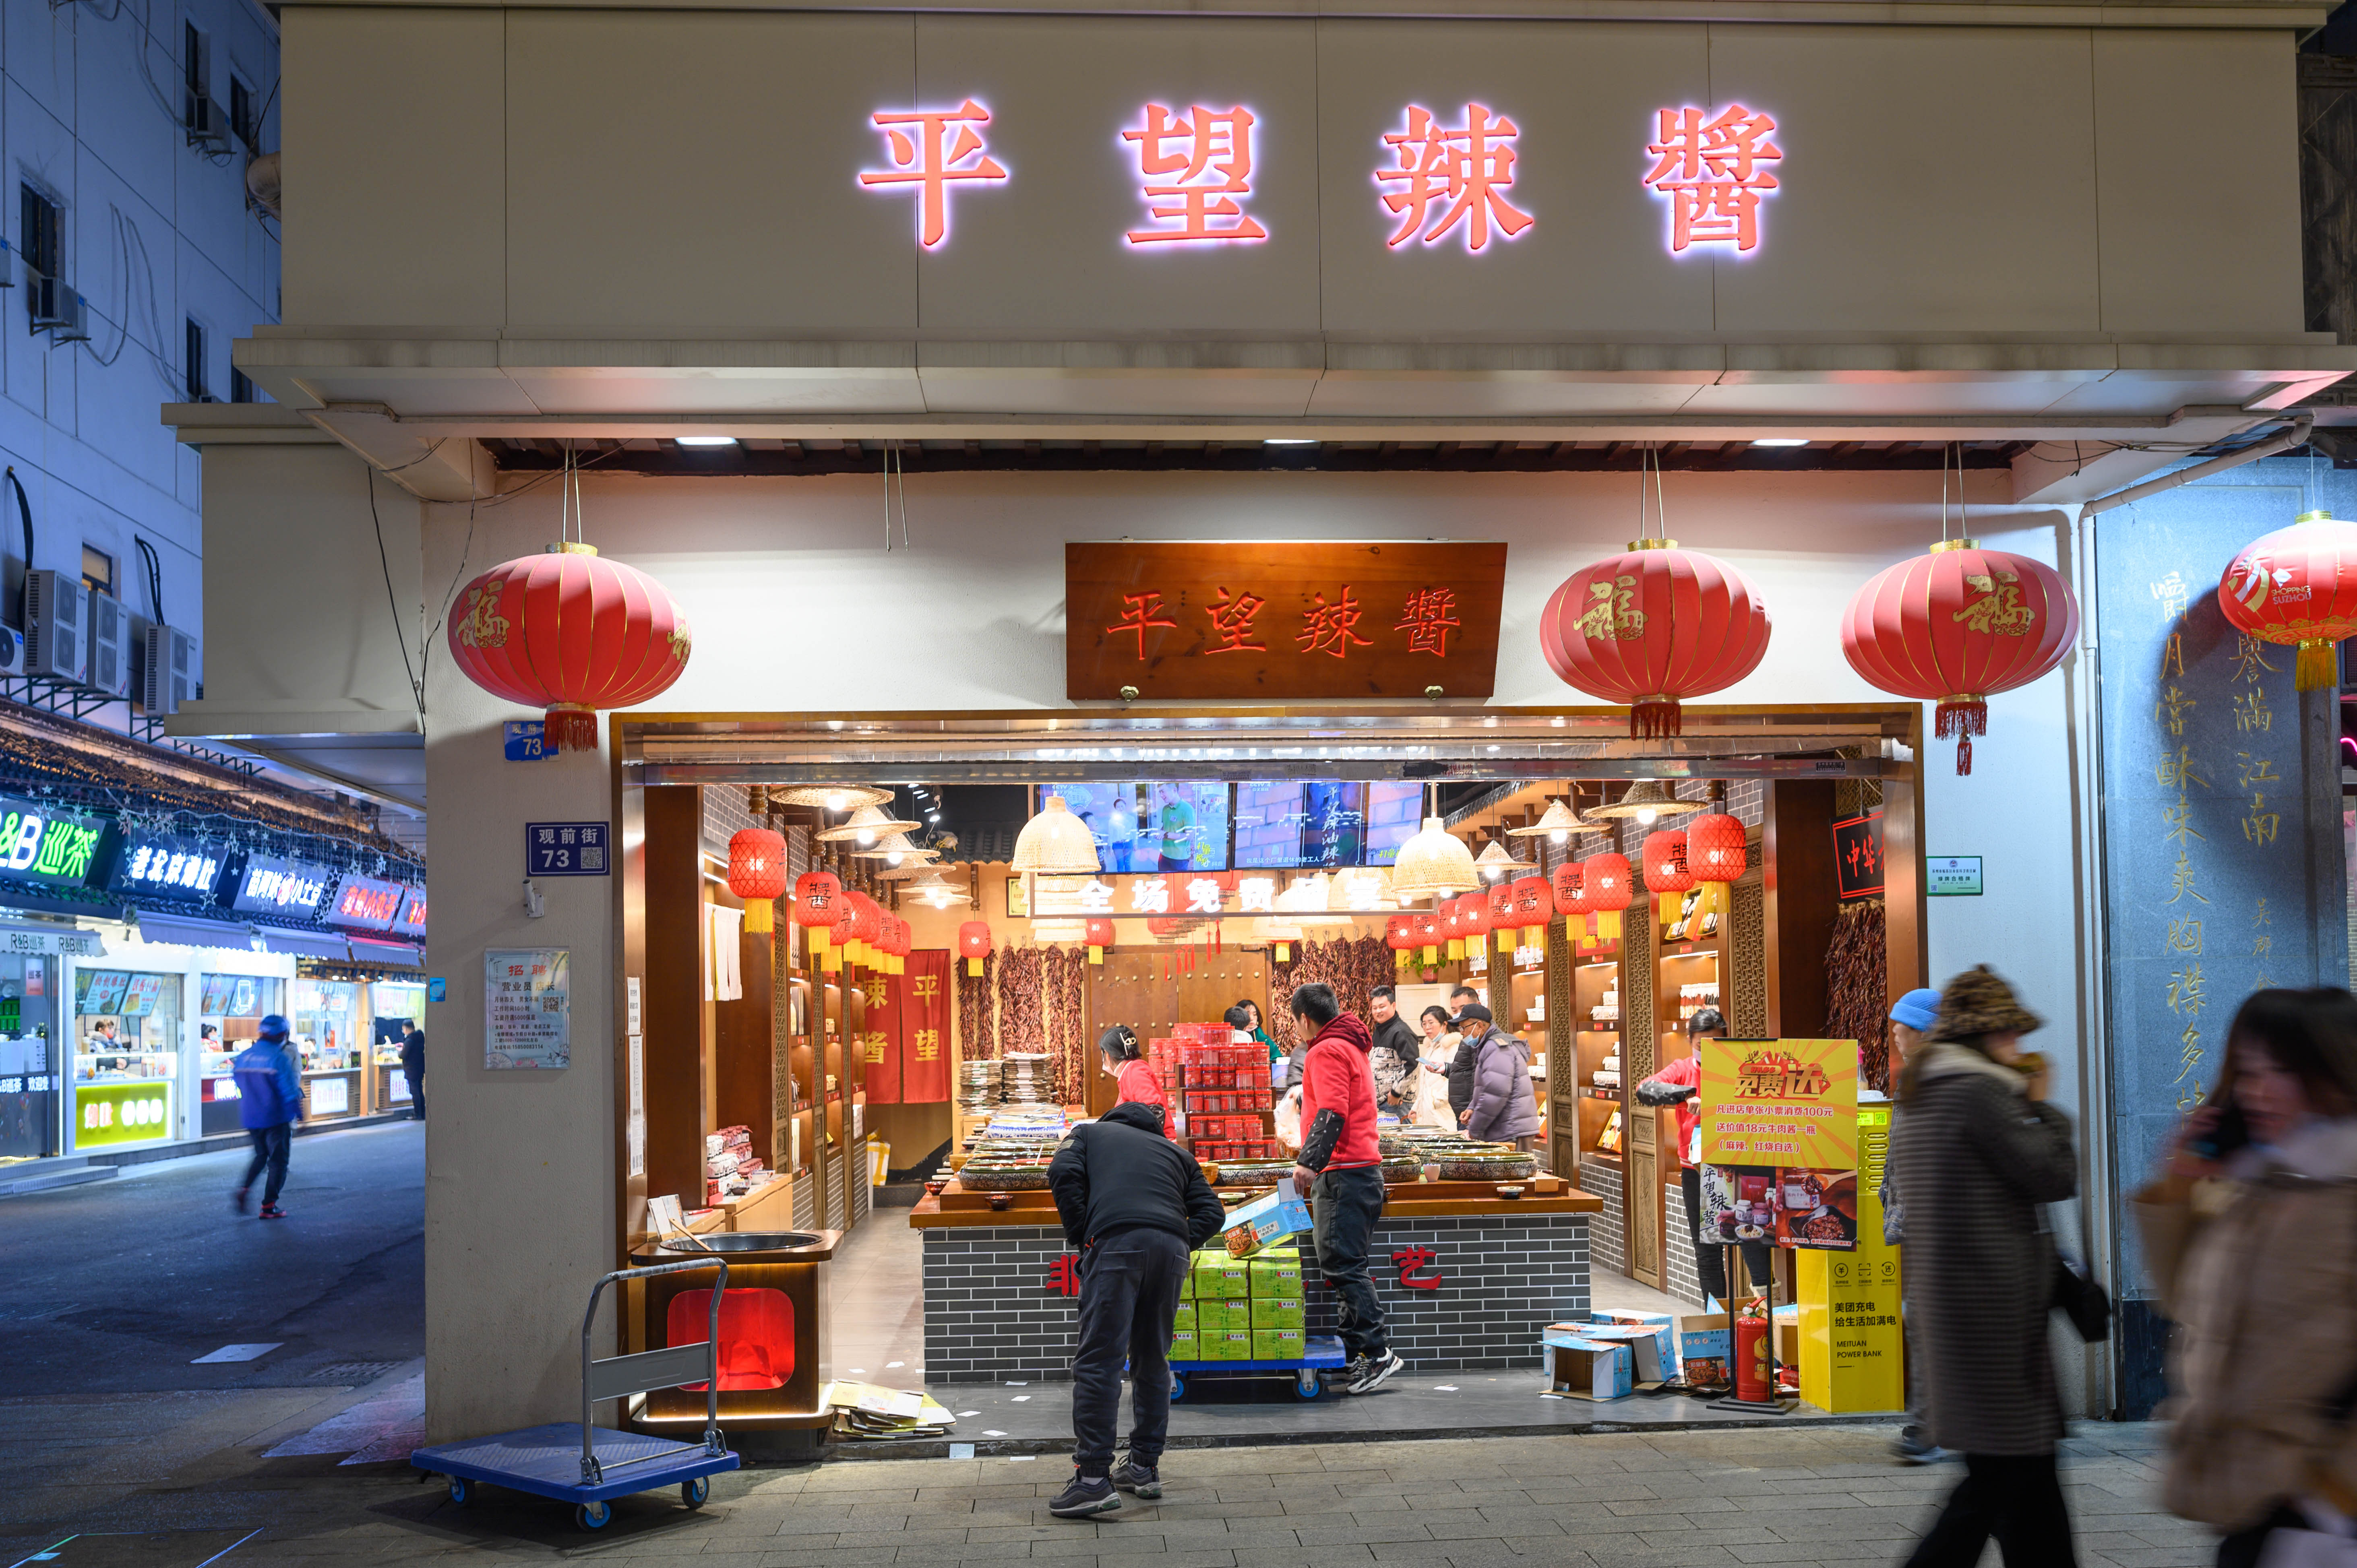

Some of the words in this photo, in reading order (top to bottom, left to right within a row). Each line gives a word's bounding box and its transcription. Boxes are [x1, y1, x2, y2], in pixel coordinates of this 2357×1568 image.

[858, 98, 1782, 250] 平望辣醬
[2271, 585, 2311, 596] SHOPPING
[2272, 592, 2312, 604] SUZHOU
[1107, 584, 1460, 659] 平望辣醬
[512, 723, 545, 735] 观前
[523, 738, 542, 755] 73
[539, 828, 598, 844] 观前街
[0, 810, 98, 878] &B巡茶
[542, 849, 569, 868] 73
[1247, 855, 1319, 864] 我是这个厂里退休的老工人
[28, 970, 41, 979] 巡茶
[508, 965, 548, 976] 招聘
[502, 981, 531, 992] 营业员
[536, 981, 555, 991] 店长
[913, 974, 940, 1062] 平望
[1733, 1063, 1824, 1099] 免费送
[1716, 1105, 1833, 1117] 凡进店单张小票消费100元
[1716, 1122, 1816, 1135] 送价值18元牛肉酱一瓶
[1392, 1245, 1442, 1290] 艺
[1835, 1302, 1875, 1313] 美团充电
[1835, 1316, 1896, 1327] 给生活加满电
